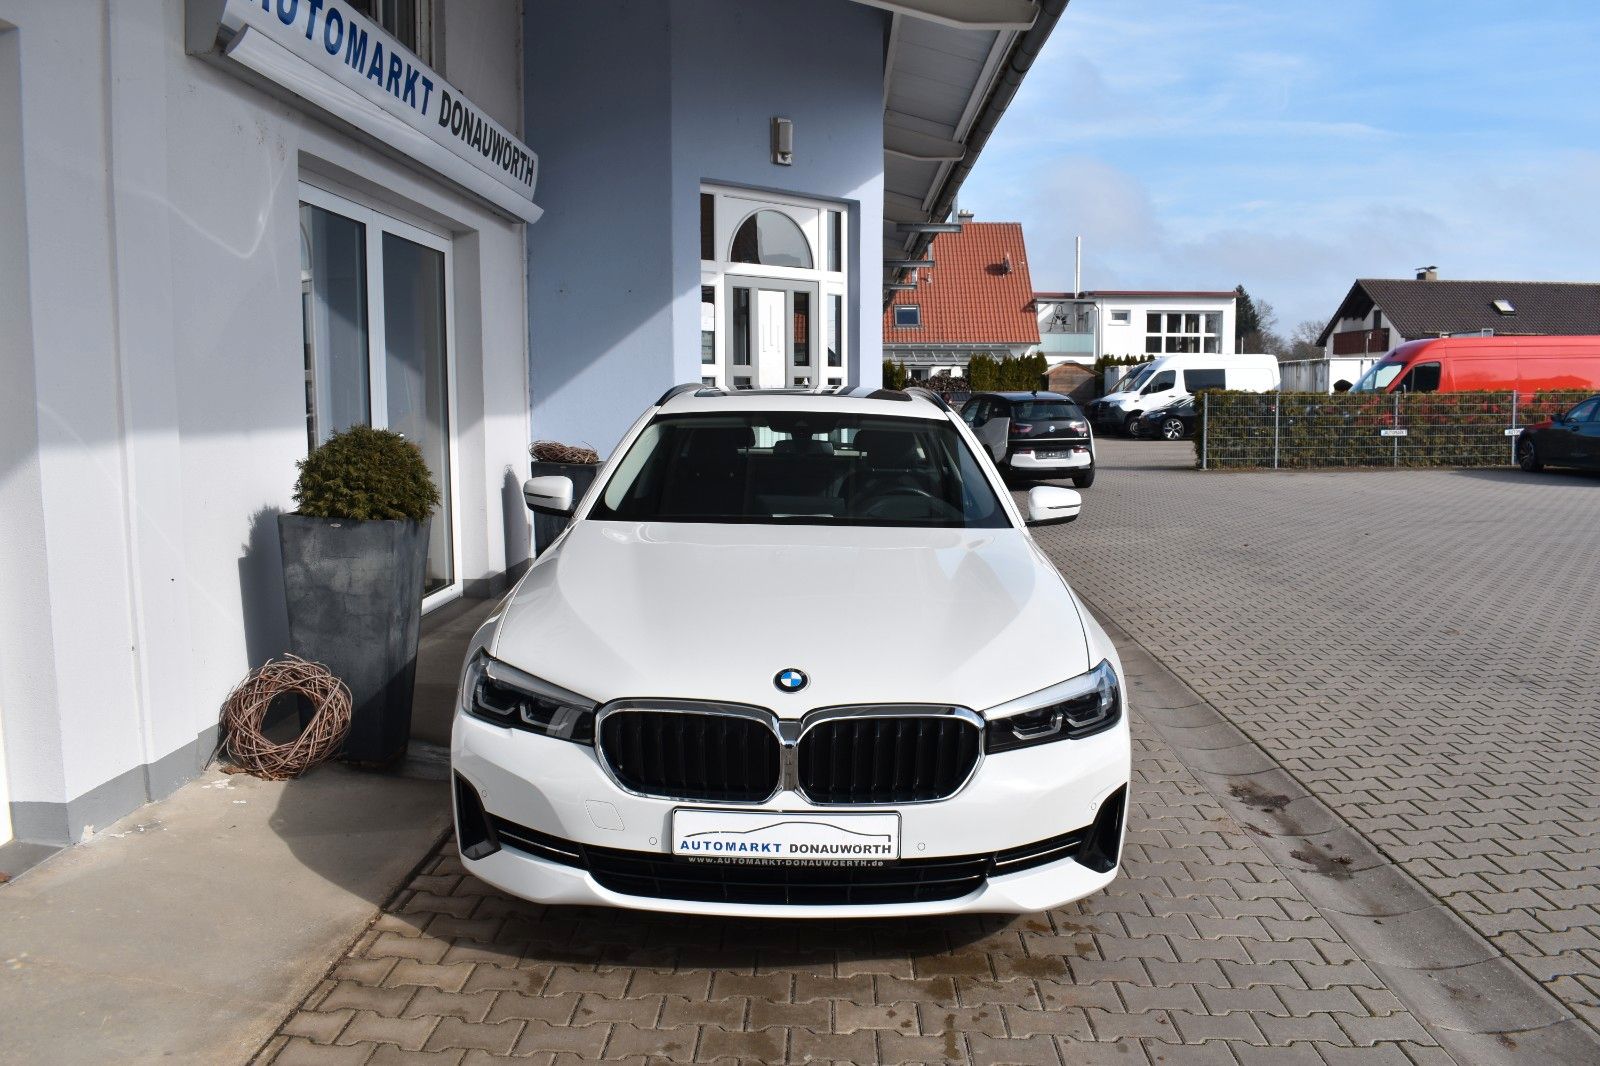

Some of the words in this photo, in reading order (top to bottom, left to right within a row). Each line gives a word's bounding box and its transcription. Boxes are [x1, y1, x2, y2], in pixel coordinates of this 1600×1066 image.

[250, 0, 434, 116] UTOMARKT
[438, 89, 534, 187] DONAUWÖRTH
[680, 840, 782, 853] AUTOMARKT
[688, 857, 884, 867] www.AUTOMARKT-DONAUWOERTH.de
